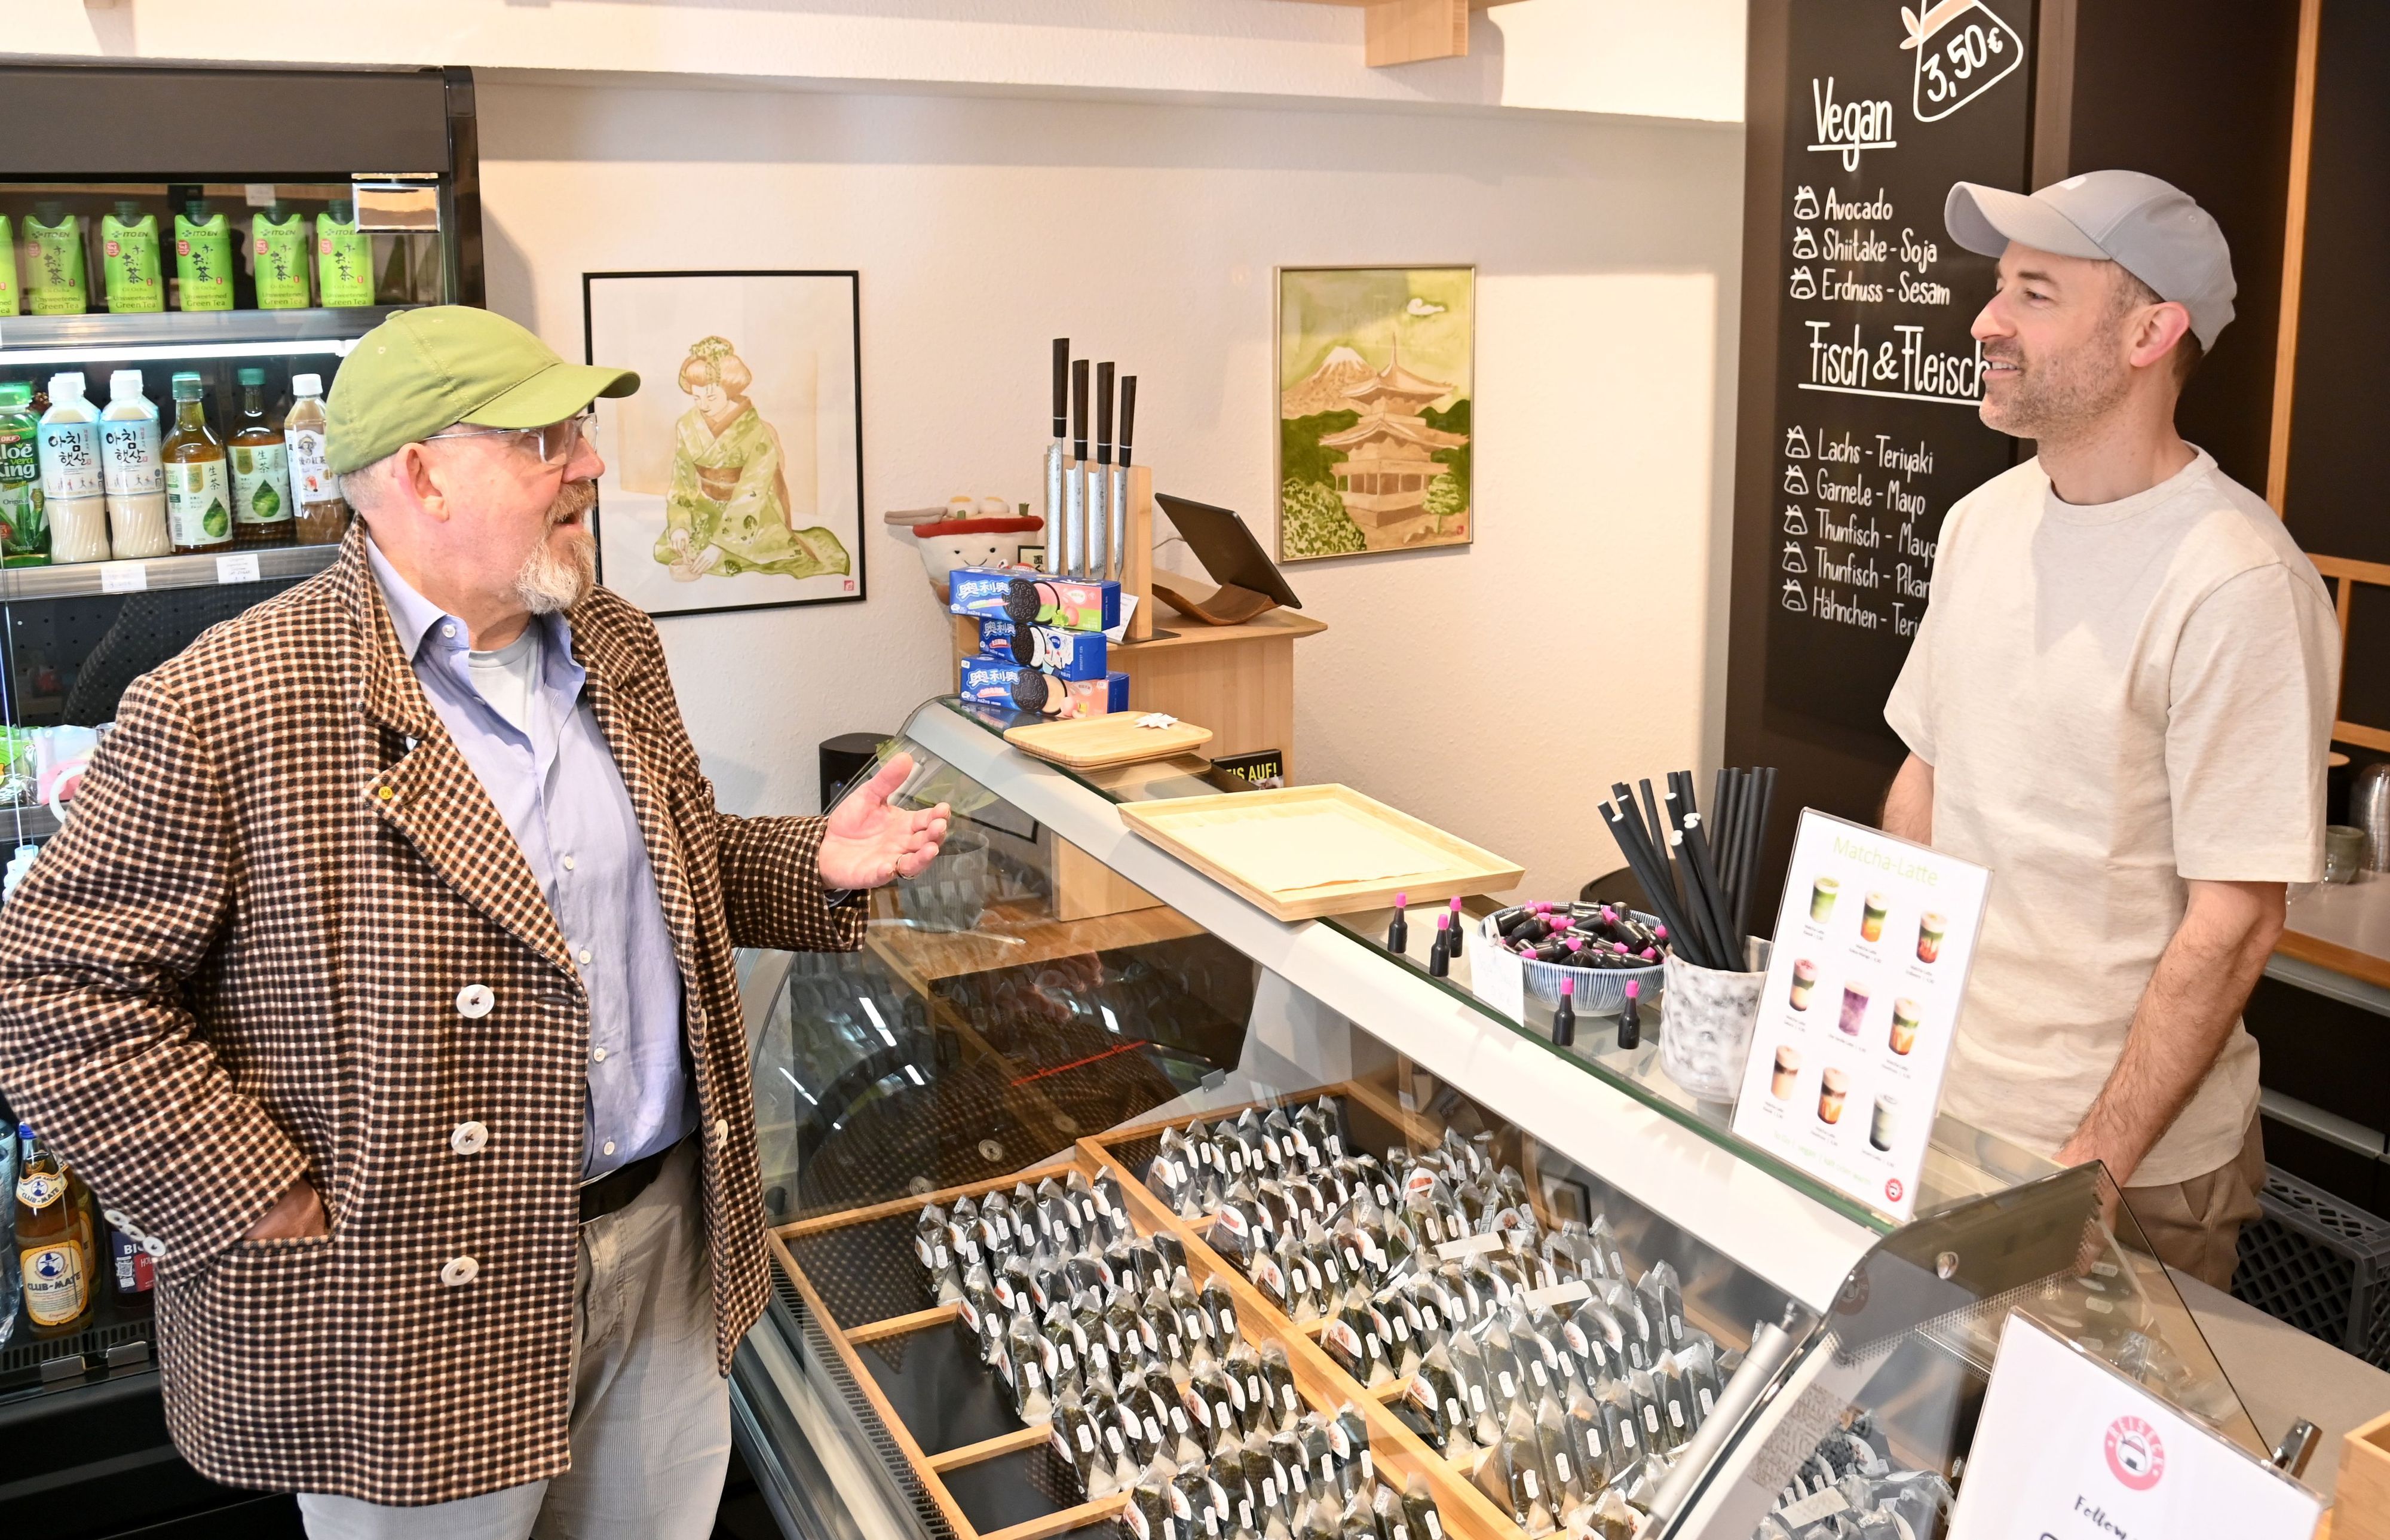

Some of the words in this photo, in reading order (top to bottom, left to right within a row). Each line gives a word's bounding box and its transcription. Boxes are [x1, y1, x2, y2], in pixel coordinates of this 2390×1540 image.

[1922, 24, 2003, 102] 3,50€
[1813, 76, 1893, 171] Vegan
[1825, 188, 1893, 220] Avocado
[1805, 320, 1869, 387] Fisch
[1873, 342, 1899, 380] &
[1893, 325, 1990, 398] Fleisch
[0, 444, 33, 460] loe
[48, 431, 81, 452] 아침
[59, 451, 89, 467] 햇살
[106, 428, 136, 449] 아침
[115, 449, 145, 464] 햇살
[1818, 428, 1860, 464] Lachs
[1876, 434, 1934, 483] Teriyaki
[1816, 468, 1872, 507] Garnele
[1887, 480, 1926, 523] Mayo
[1815, 507, 1879, 549] Thunfisch
[1814, 546, 1879, 589] Thunfisch
[1813, 586, 1877, 630] Hähnchen
[1892, 602, 1920, 638] Teri
[1833, 836, 1938, 886] Matcha-Latte
[2074, 1493, 2127, 1540] Follow
